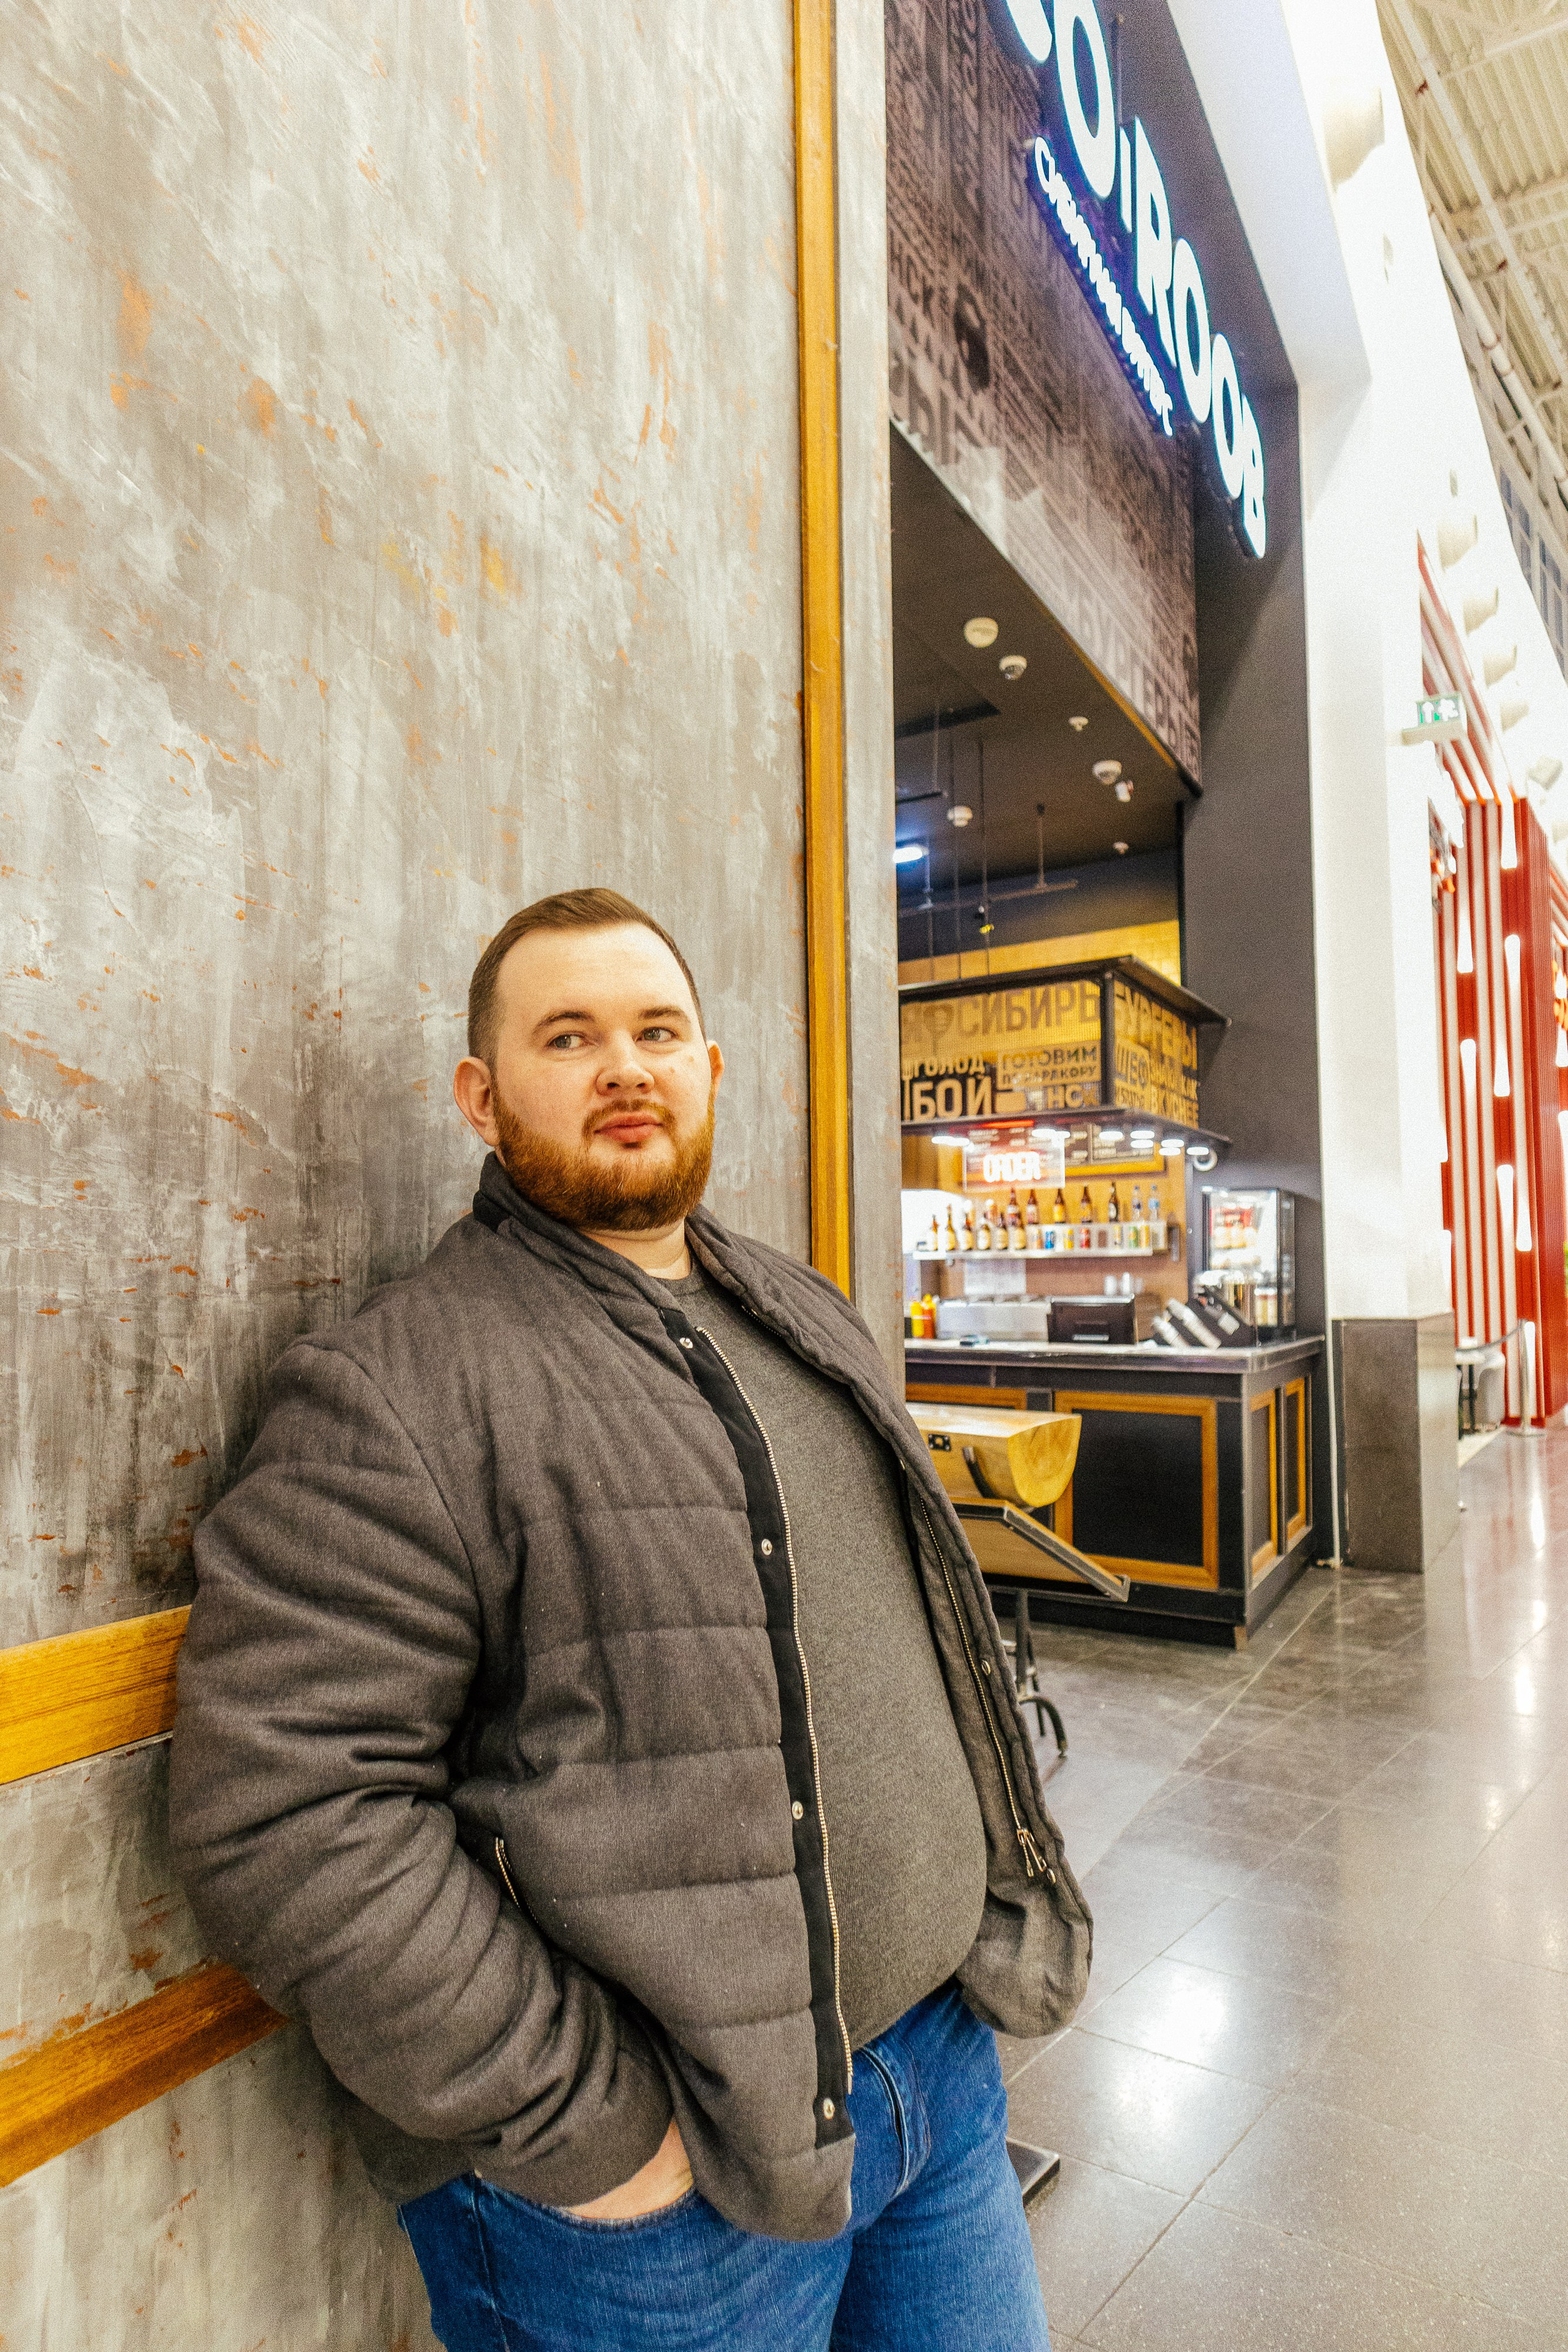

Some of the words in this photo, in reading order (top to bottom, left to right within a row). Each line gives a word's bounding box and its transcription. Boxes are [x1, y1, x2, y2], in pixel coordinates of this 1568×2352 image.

[957, 979, 1099, 1036] СИБИРЬ
[1002, 1046, 1097, 1070] ГОТОВИМ
[913, 1072, 992, 1120] БОЙ
[1047, 1084, 1099, 1109] НСК
